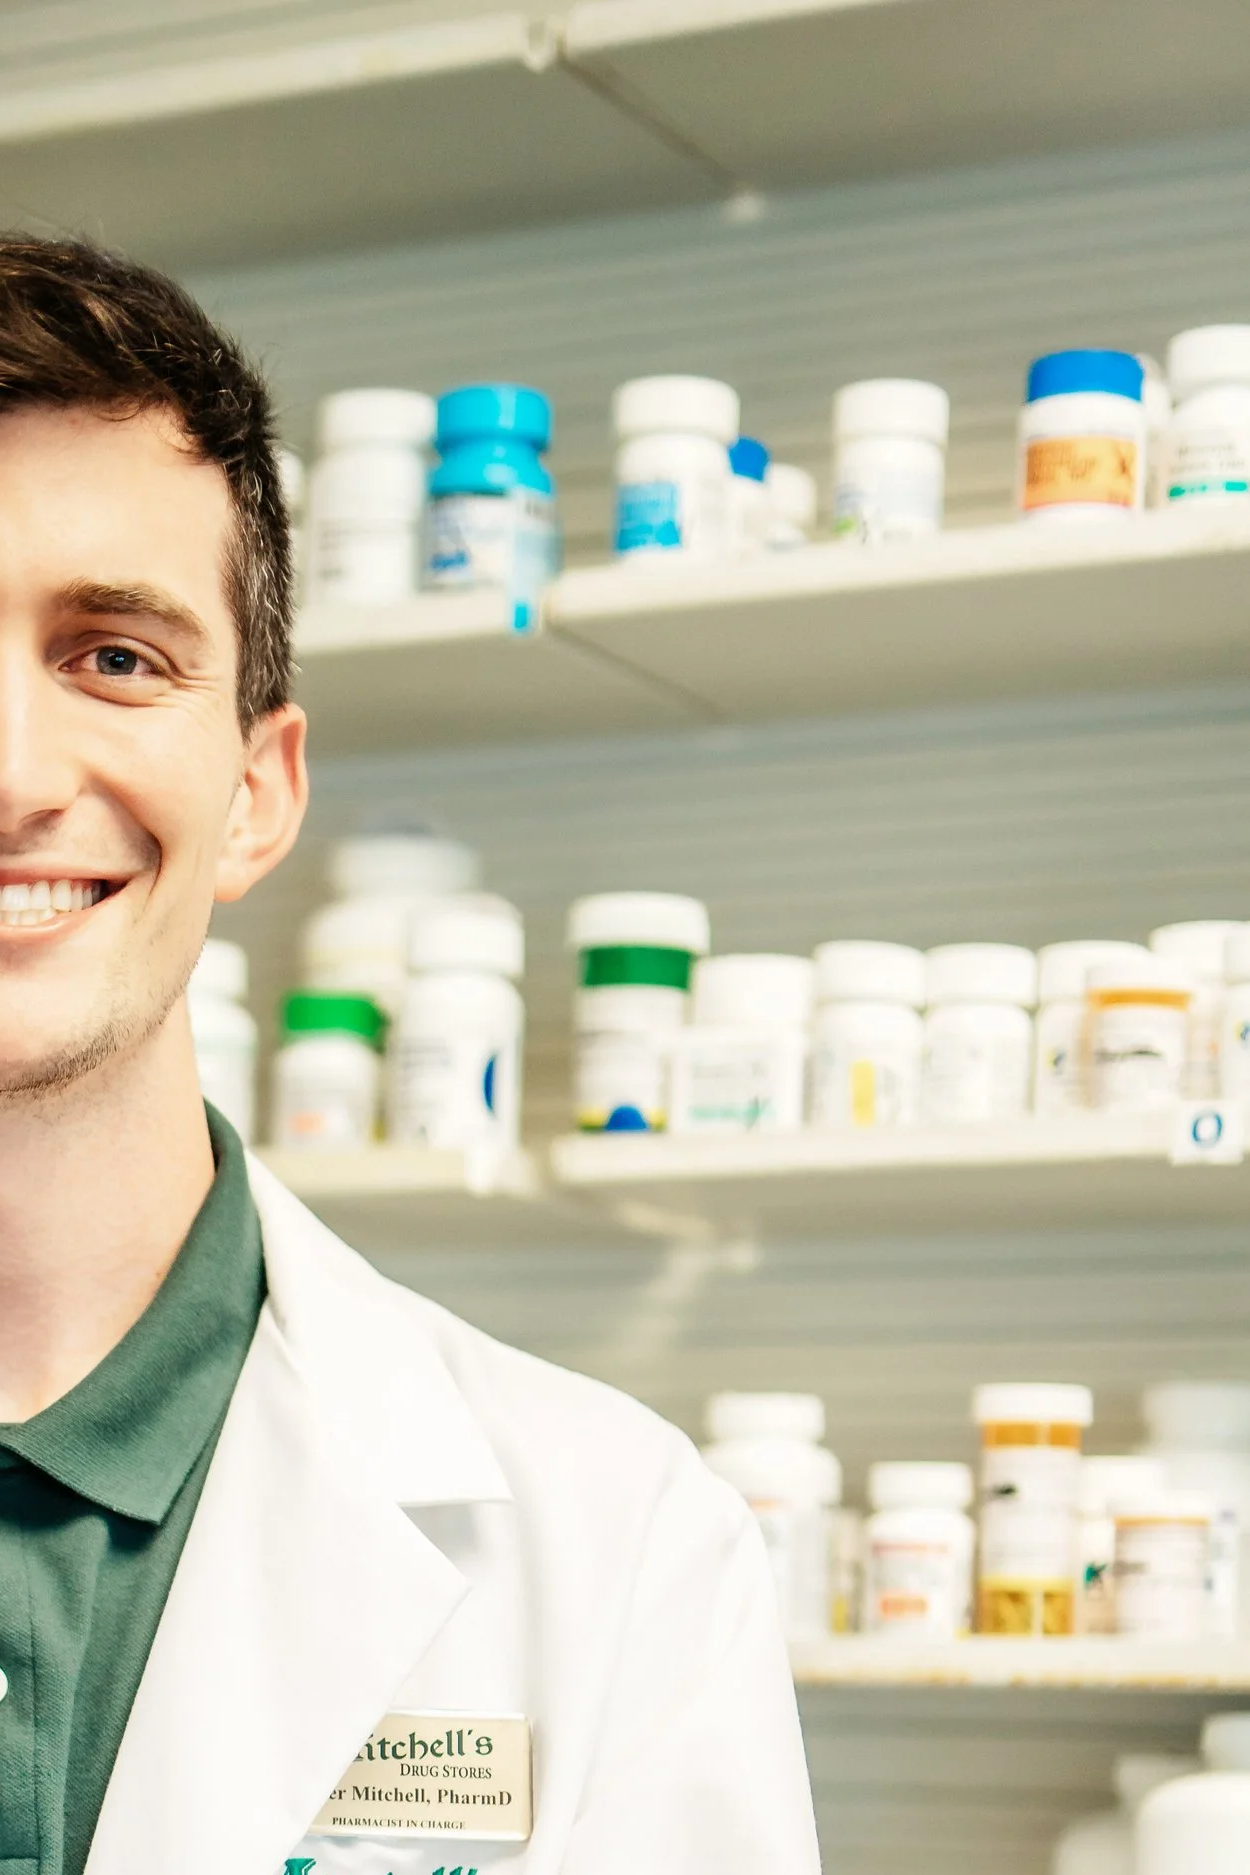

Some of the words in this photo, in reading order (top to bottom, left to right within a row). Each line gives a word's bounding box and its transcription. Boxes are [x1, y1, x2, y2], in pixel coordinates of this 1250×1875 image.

[354, 1729, 494, 1762] itchell's
[399, 1763, 439, 1778] DRUG
[442, 1764, 492, 1779] STORES
[329, 1789, 347, 1801] er
[352, 1786, 431, 1806] Mitchell,
[437, 1788, 513, 1806] PharmD
[332, 1816, 403, 1828] PHARMACIST
[406, 1819, 418, 1828] IN
[420, 1819, 467, 1830] CHARGE
